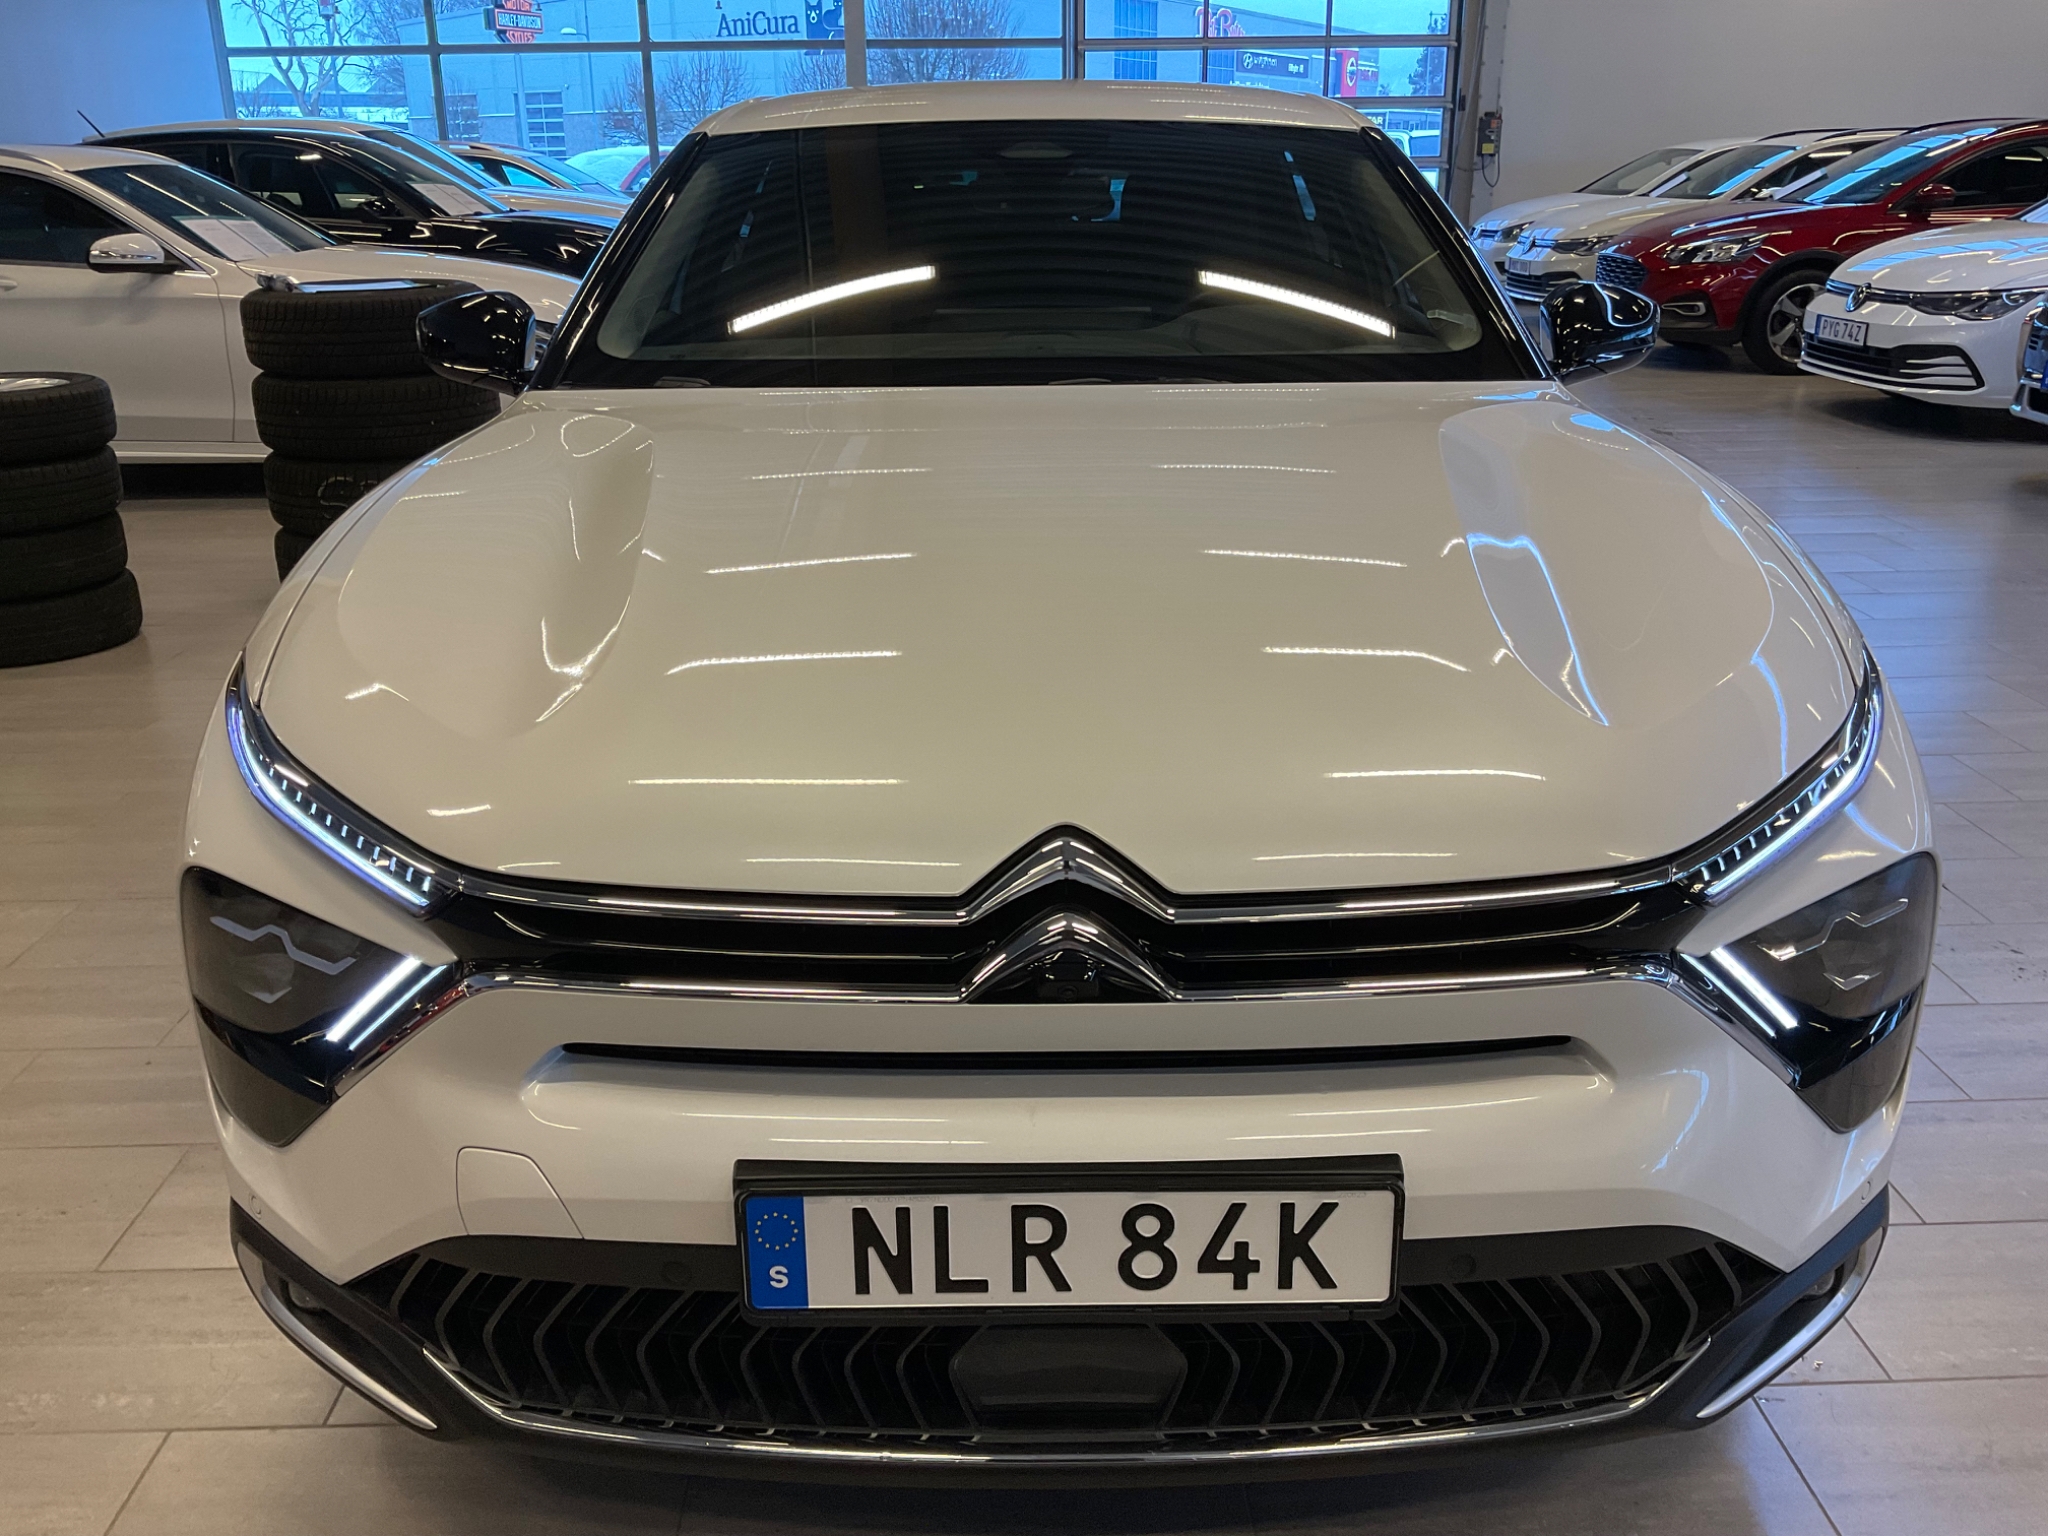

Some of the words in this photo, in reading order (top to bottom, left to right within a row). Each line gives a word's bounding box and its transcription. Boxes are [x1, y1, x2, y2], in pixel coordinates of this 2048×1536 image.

[498, 12, 542, 29] HARLEY-DAVIDSON
[716, 10, 800, 38] AniCura
[1821, 317, 1841, 337] PYG
[1842, 322, 1863, 343] 74Z
[851, 1203, 1072, 1296] NLR
[1117, 1201, 1340, 1292] 84K
[768, 1265, 789, 1290] S
